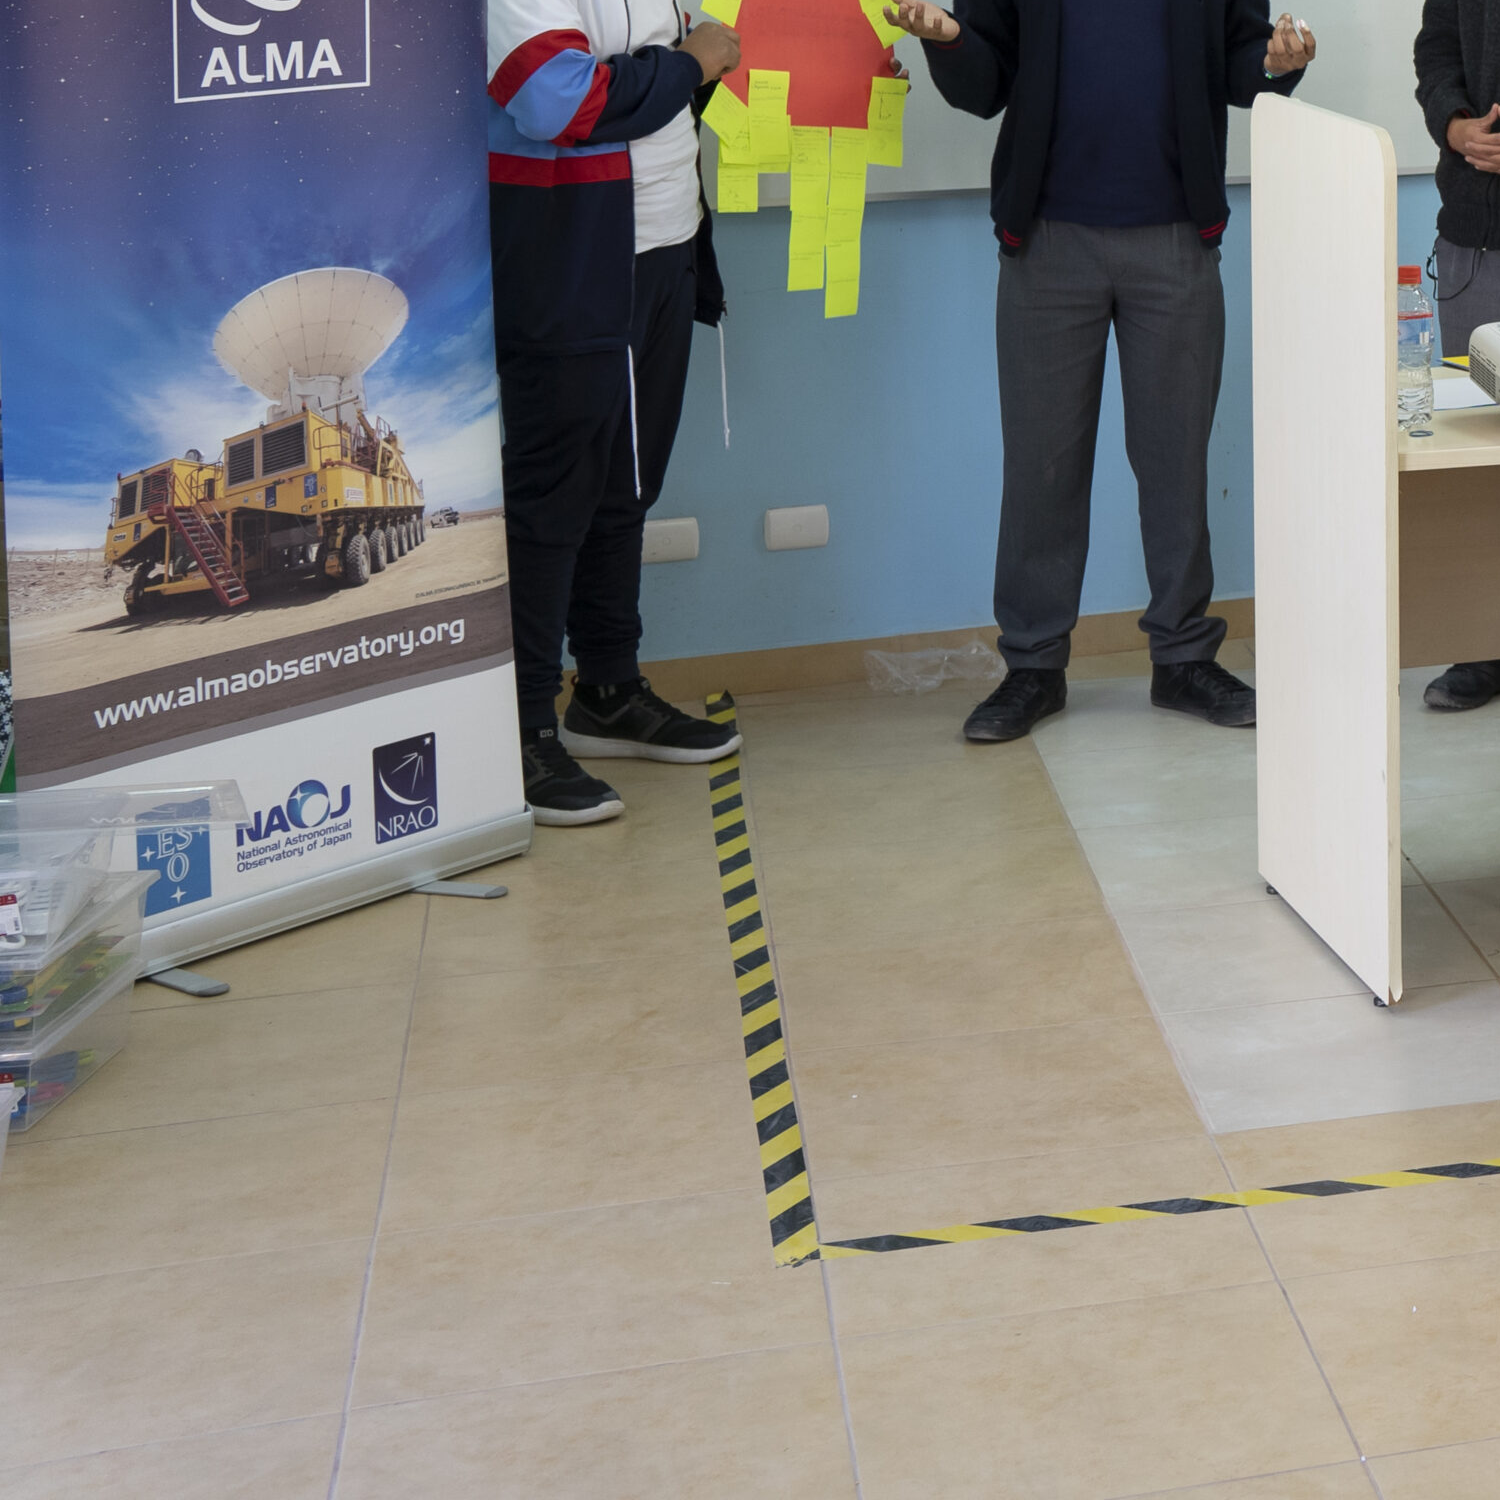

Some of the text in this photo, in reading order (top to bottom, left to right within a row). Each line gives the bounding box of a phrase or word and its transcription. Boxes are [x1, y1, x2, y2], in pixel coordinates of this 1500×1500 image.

[200, 38, 344, 88] ALMA
[93, 618, 466, 730] www.almaobservatory.org
[235, 779, 351, 847] NAOJ
[376, 805, 437, 842] NRAO
[236, 818, 353, 862] National Astronomical
[236, 832, 352, 874] Observatory of Japan
